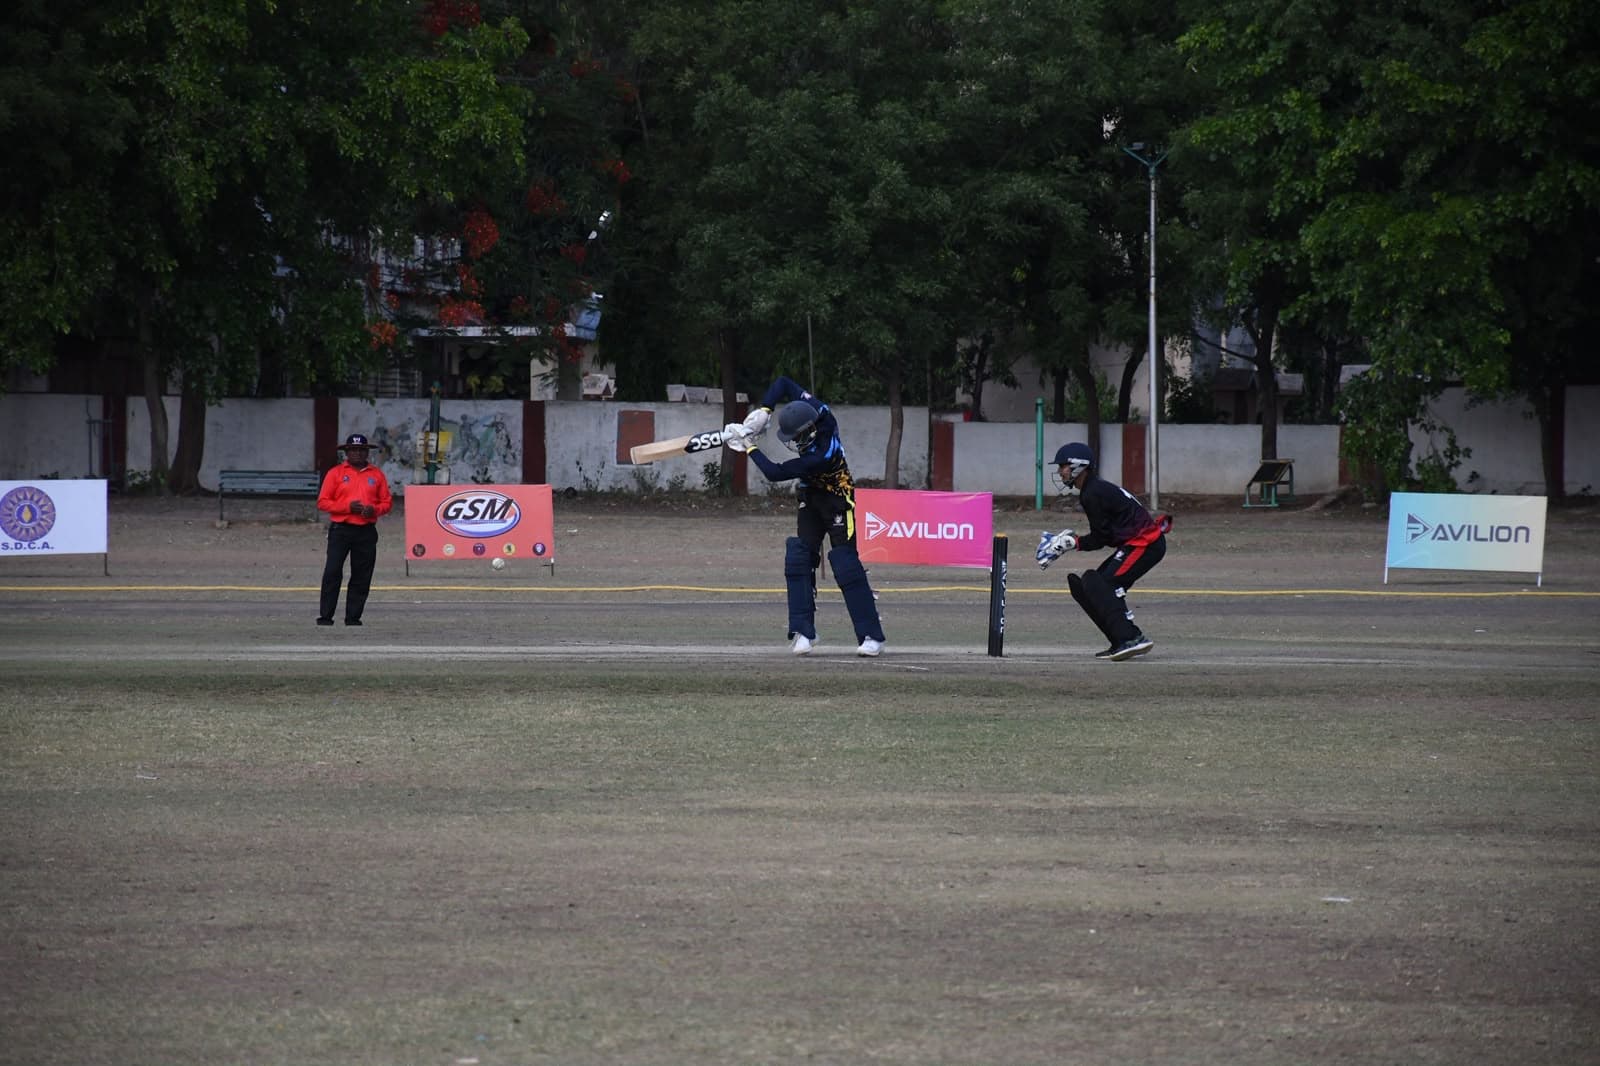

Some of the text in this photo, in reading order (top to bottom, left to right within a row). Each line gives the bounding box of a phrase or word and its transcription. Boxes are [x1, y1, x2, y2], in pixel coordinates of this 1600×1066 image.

[691, 432, 722, 450] DSC
[443, 498, 514, 520] GSM
[865, 511, 975, 541] PAVILION
[1405, 512, 1531, 544] PAVILION
[1, 541, 55, 551] S.D.C.A.
